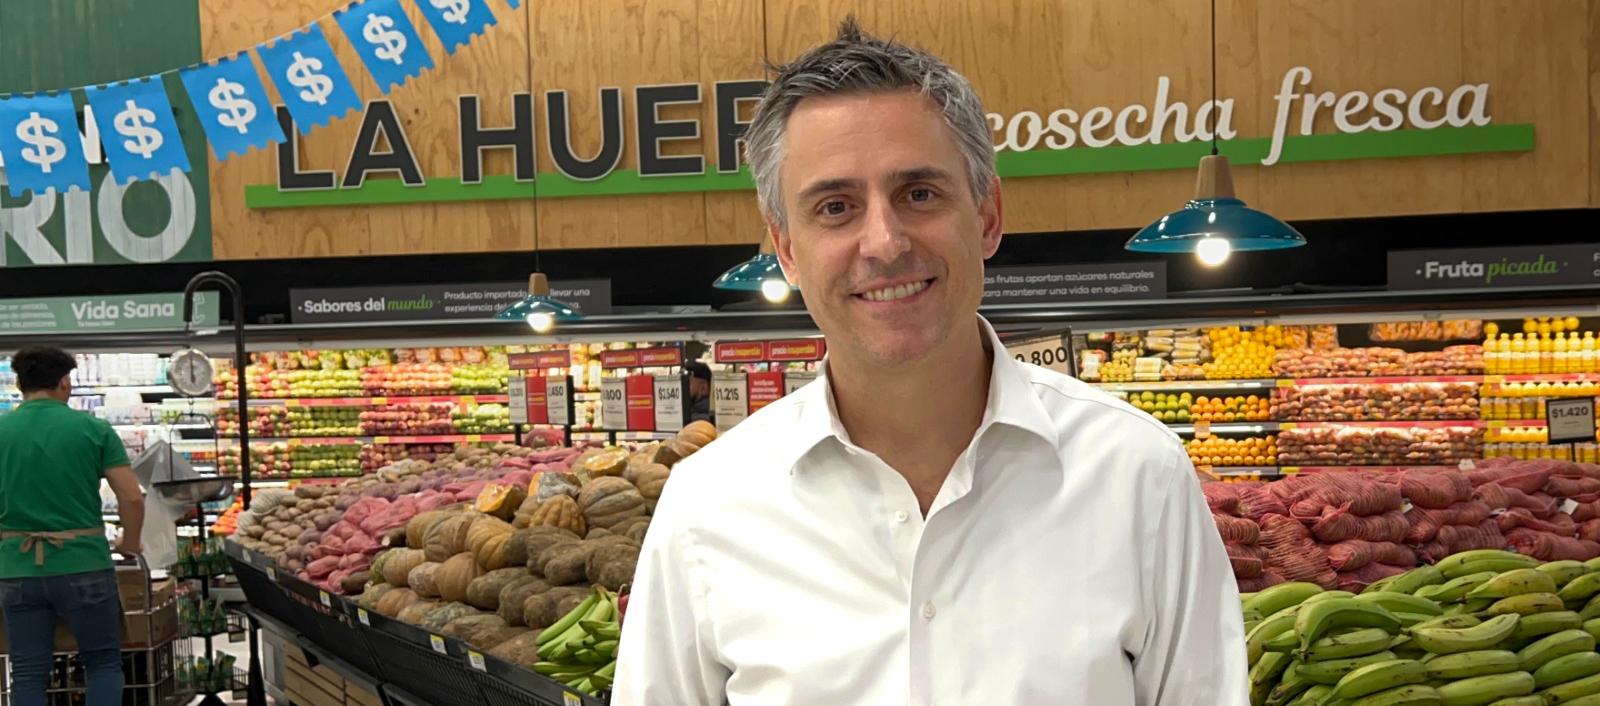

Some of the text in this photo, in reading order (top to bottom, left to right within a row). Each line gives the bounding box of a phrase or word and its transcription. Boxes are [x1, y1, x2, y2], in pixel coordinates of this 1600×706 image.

[363, 13, 408, 65] $
[286, 51, 334, 106] $
[208, 78, 257, 134] $
[984, 66, 1492, 166] cosecha fresca
[16, 112, 67, 173] $
[113, 99, 163, 159] $
[275, 98, 426, 192] LA
[996, 274, 1025, 283] frutas
[1025, 273, 1064, 284] aportan
[1065, 271, 1108, 282] azúcares
[1109, 270, 1155, 280] naturales
[1425, 254, 1559, 284] Fruta picada
[304, 294, 433, 314] Sabores del mundo
[444, 290, 483, 301] Producto
[1002, 287, 1049, 297] mantener
[1069, 285, 1090, 295] vida
[1091, 286, 1104, 294] en
[71, 300, 119, 320] Vida
[122, 300, 175, 318] Sana
[445, 302, 494, 314] experiencia
[1551, 406, 1589, 418] $1.420
